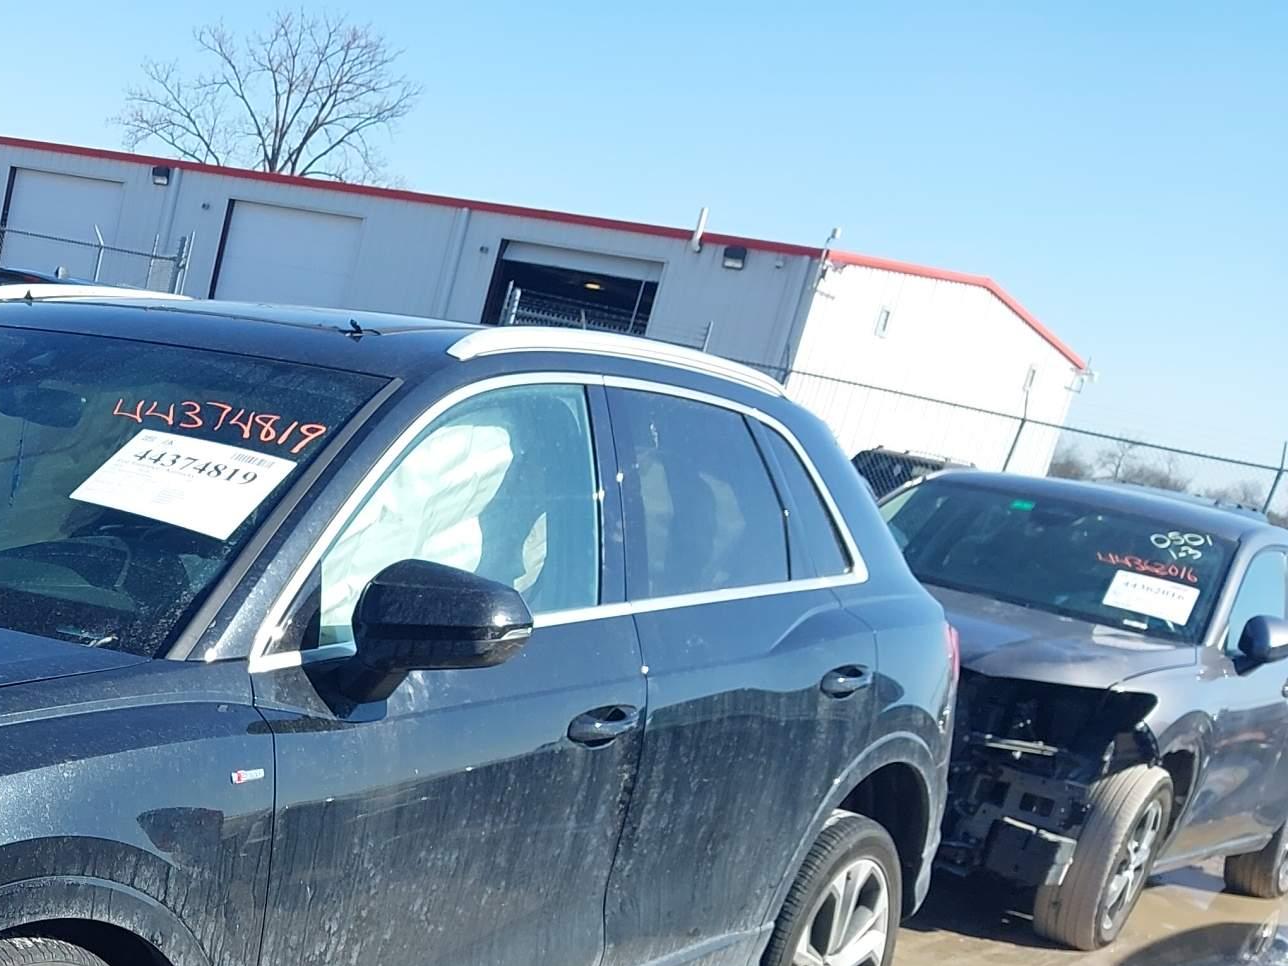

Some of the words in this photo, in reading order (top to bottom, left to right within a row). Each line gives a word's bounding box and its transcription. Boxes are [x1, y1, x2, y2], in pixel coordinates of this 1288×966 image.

[113, 398, 328, 454] 44374819
[133, 449, 258, 485] 44374819
[1150, 531, 1213, 549] 0501
